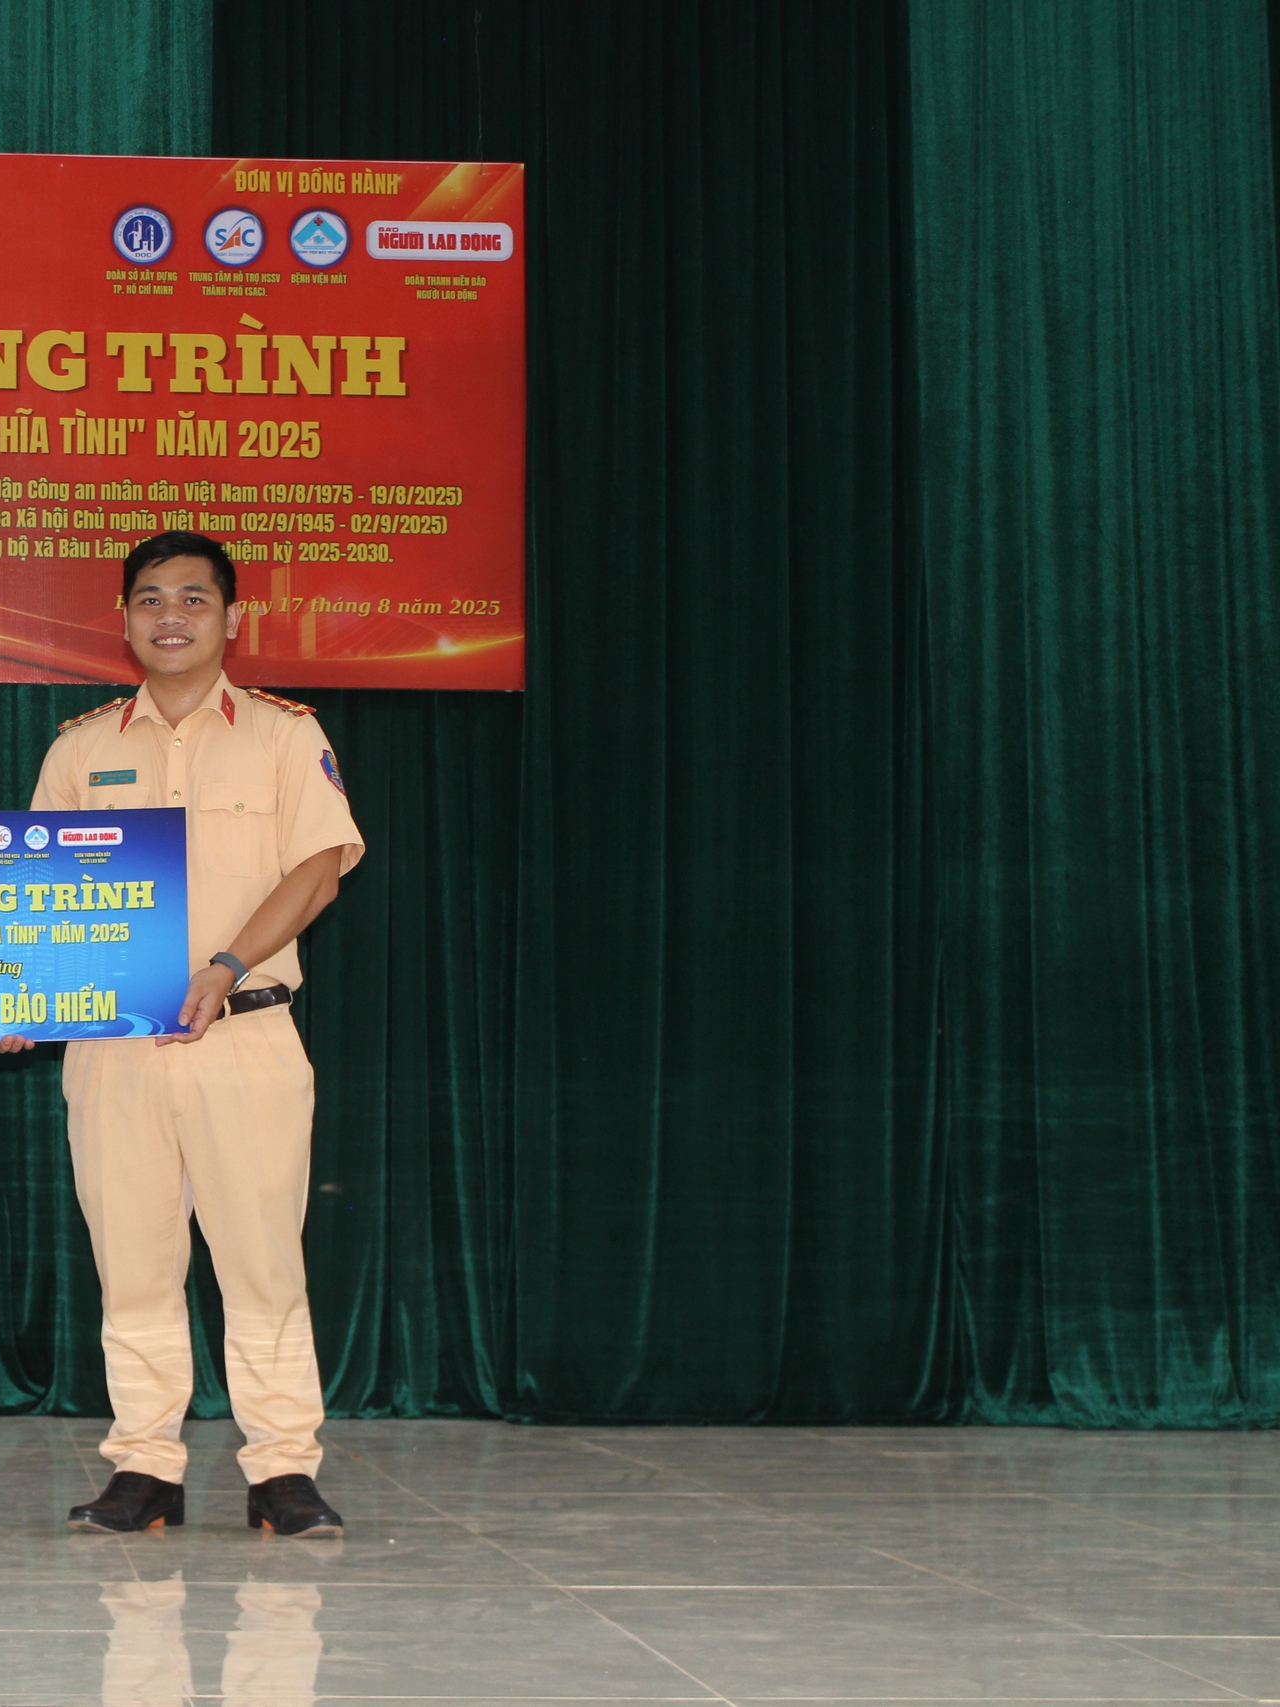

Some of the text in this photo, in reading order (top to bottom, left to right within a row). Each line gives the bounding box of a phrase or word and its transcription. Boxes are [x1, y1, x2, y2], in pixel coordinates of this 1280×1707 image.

[235, 168, 398, 197] ĐƠN VỊ ĐỒNG HÀNH
[215, 227, 255, 251] SAC
[378, 231, 501, 251] NGƯỜI LAO ĐỘNG
[106, 268, 177, 283] ĐOÀN SỞ XÂY DỰNG
[189, 271, 212, 282] TRUNG
[215, 270, 231, 282] TÂM
[245, 272, 259, 285] TRỢ
[261, 272, 280, 283] HSSV
[291, 272, 310, 285] BỆNH
[312, 272, 328, 285] VIỆN
[405, 274, 486, 287] ĐOÀN THANH NIÊN BÁO
[113, 283, 173, 295] TP. HỒ CHÍ MINH
[202, 284, 226, 296] THÀNH
[228, 284, 243, 296] PHỐ
[417, 288, 477, 302] NGƯỜI LAO ĐỘNG
[106, 313, 407, 398] TRÌNH
[59, 408, 145, 455] TÌNH"
[156, 410, 227, 457] NĂM
[238, 420, 321, 459] 2025
[27, 477, 70, 502] Công
[74, 482, 95, 500] an
[100, 478, 143, 501] nhân
[147, 479, 179, 502] dân
[184, 480, 216, 506] Việt
[221, 483, 257, 503] Nam
[262, 484, 353, 504] (19/8/1975
[369, 486, 462, 506] 19/8/2025)
[16, 506, 37, 528] Xã
[42, 506, 67, 532] hội
[73, 506, 104, 530] Chủ
[110, 510, 157, 532] nghĩa
[162, 509, 194, 532] Việt
[199, 512, 235, 532] Nam
[241, 512, 335, 534] (02/9/1945
[350, 514, 448, 535] 02/9/2025)
[7, 535, 29, 561] bộ
[34, 536, 54, 558] xã
[58, 537, 90, 559] Bàu
[95, 536, 129, 559] Lâm
[223, 539, 268, 565] hiệm
[273, 539, 293, 564] kỳ
[298, 542, 394, 563] 2025-2030.
[279, 597, 304, 612] 17
[311, 596, 371, 617] tháng
[377, 598, 391, 614] 8
[398, 598, 442, 614] năm
[449, 599, 500, 616] 2025
[25, 874, 155, 912] TRÌNH
[51, 920, 85, 944] NĂM
[90, 923, 129, 942] 2025
[0, 983, 47, 1023] BẢO
[55, 982, 117, 1023] HIỂM
